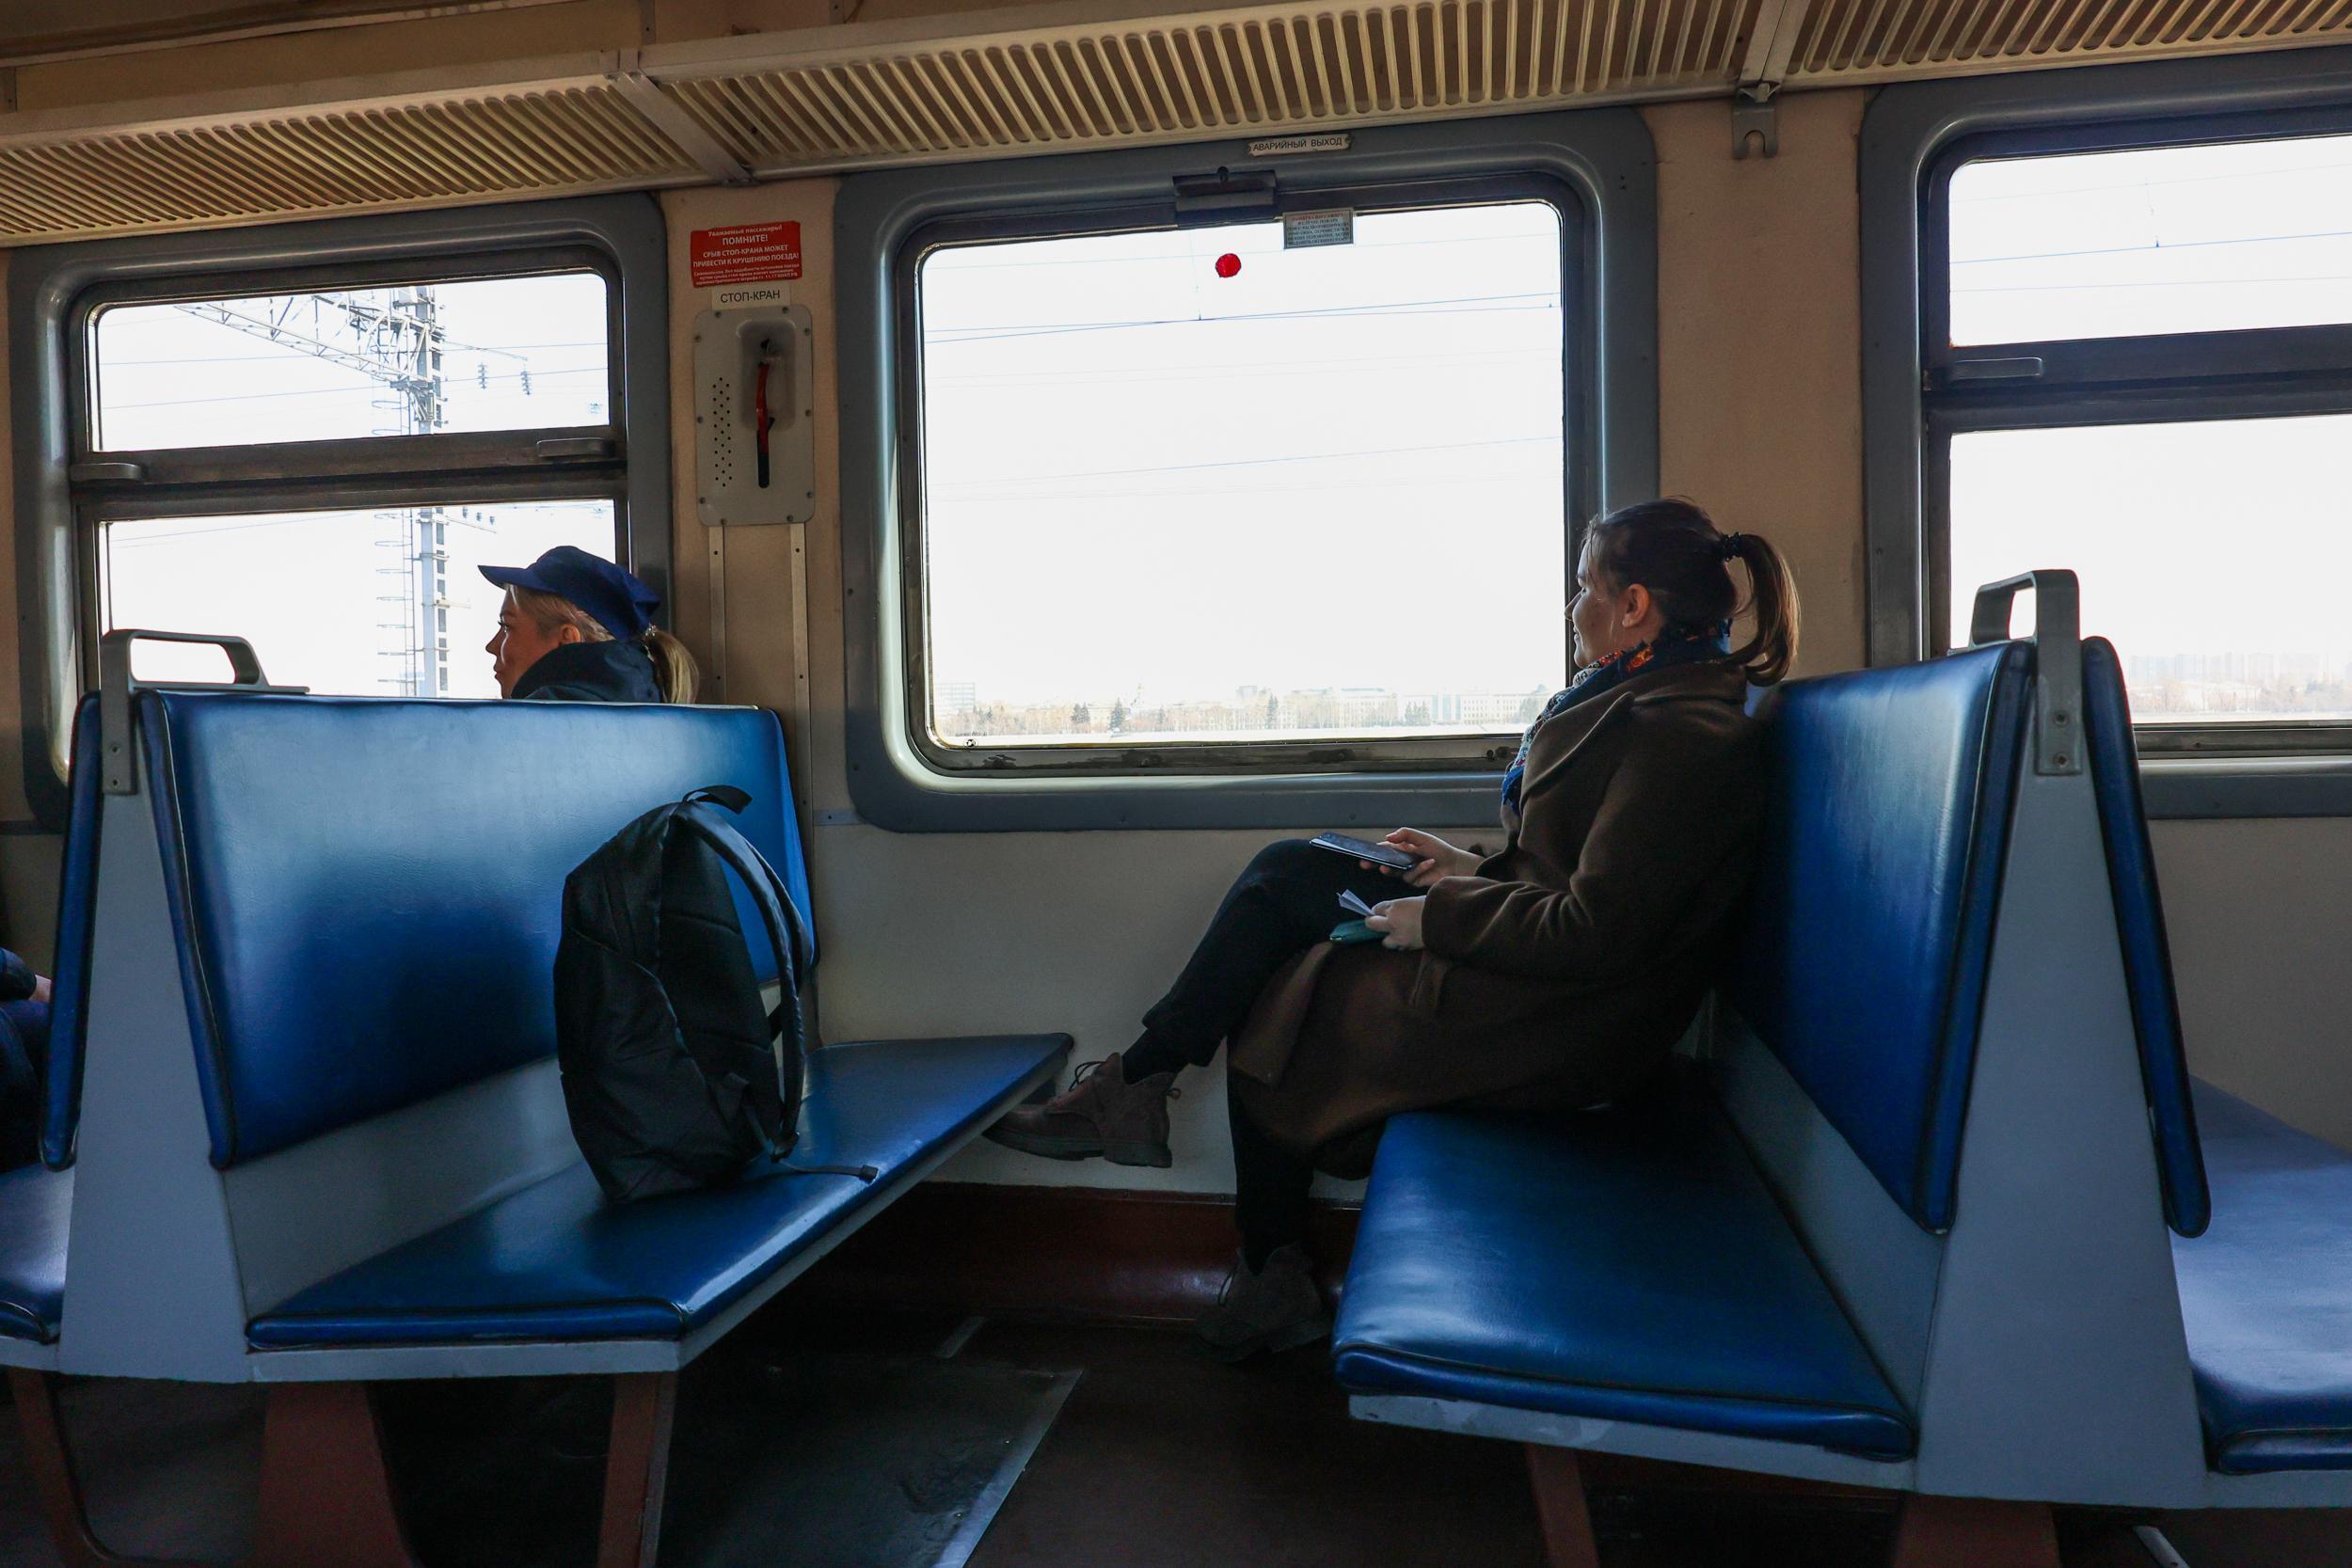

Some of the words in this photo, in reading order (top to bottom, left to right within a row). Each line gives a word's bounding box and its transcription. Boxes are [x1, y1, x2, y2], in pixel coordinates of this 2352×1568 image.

[1253, 139, 1307, 151] АВАРИЙНЫЙ
[1311, 137, 1343, 147] ВЫХОД
[723, 234, 769, 245] ПОМНИТЕ!
[722, 246, 763, 257] СТОП-КРАНА
[693, 259, 726, 268] ПРИВЕСТИ
[732, 255, 771, 264] КРУШЕНИЮ
[771, 252, 799, 261] ПОЕЗДА!
[720, 290, 780, 303] СТОП-КРАН
